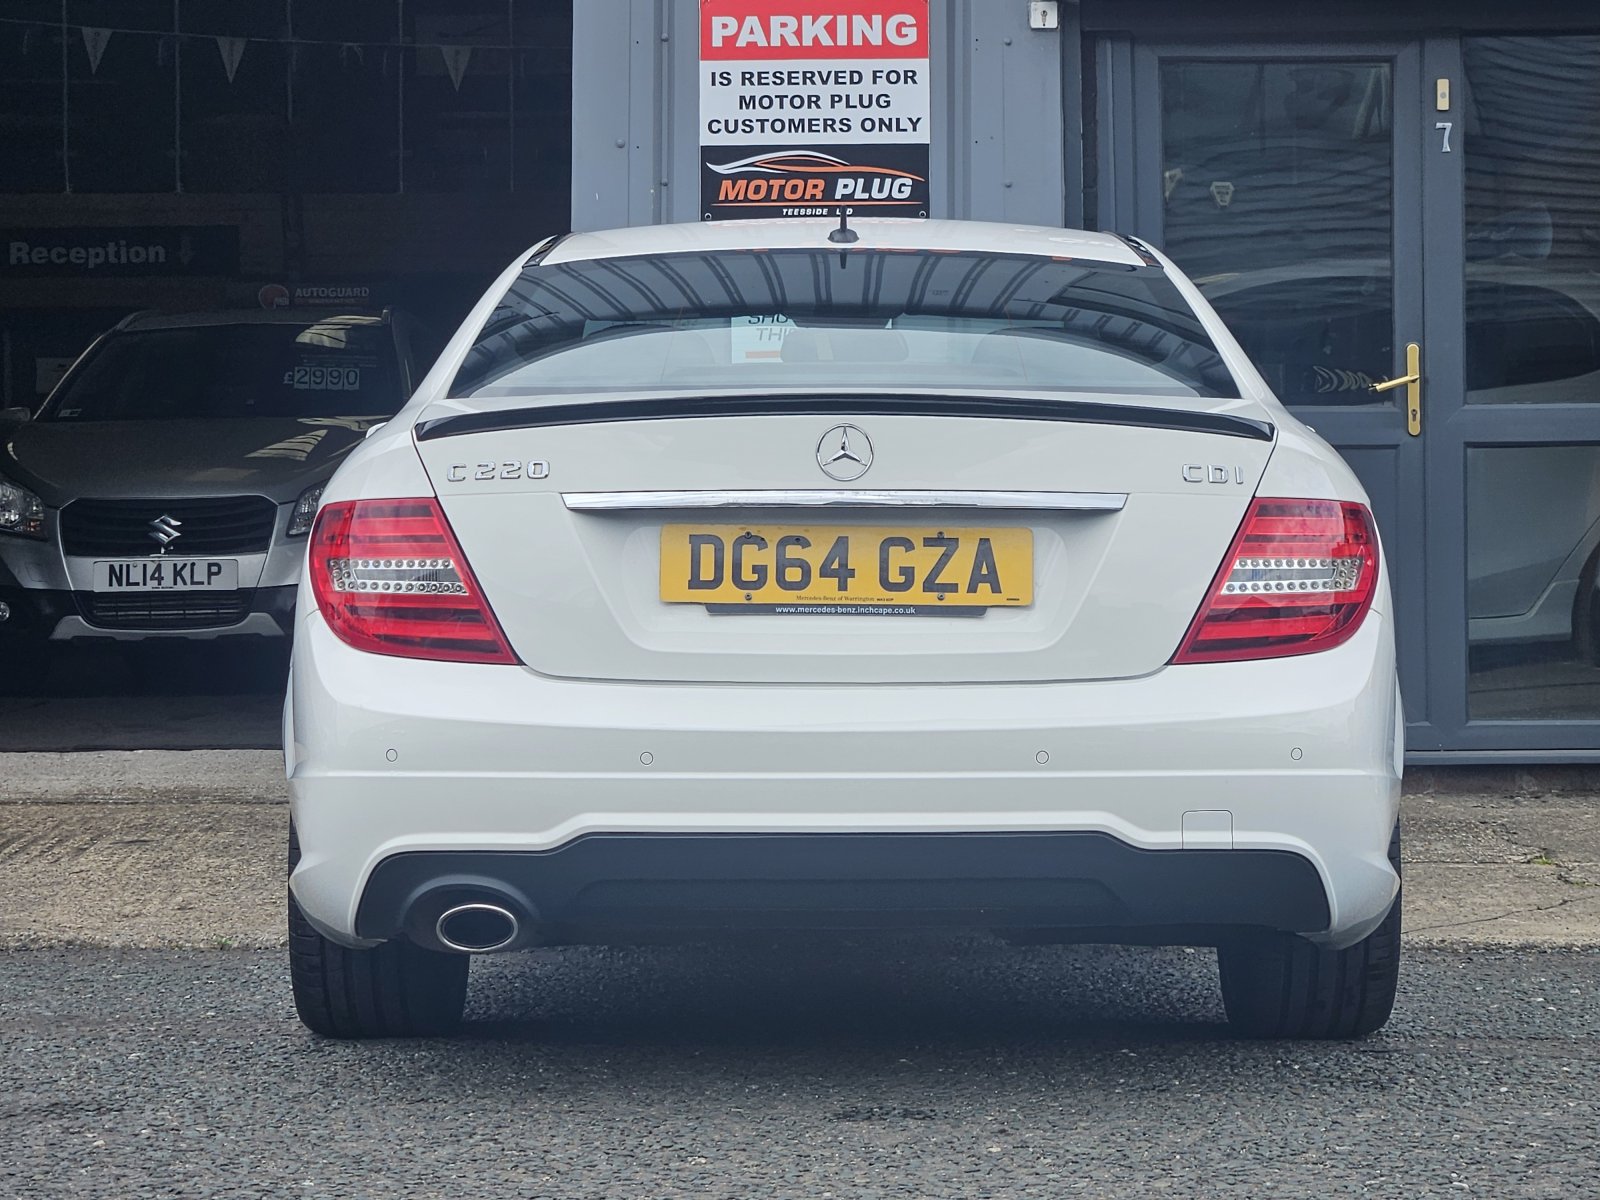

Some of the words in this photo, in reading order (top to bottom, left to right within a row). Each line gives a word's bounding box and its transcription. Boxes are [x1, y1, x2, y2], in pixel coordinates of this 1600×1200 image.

[711, 14, 918, 47] PARKING
[711, 71, 732, 86] IS
[741, 70, 863, 86] RESERVED
[872, 70, 918, 85] FOR
[739, 94, 821, 110] MOTOR
[830, 93, 891, 109] PLUG
[707, 118, 852, 134] CUSTOMERS
[860, 117, 922, 132] ONLY
[1435, 122, 1452, 152] 7
[718, 179, 825, 201] MOTOR
[834, 178, 913, 200] PLUG
[782, 208, 828, 216] TEESSIDE
[9, 240, 166, 268] Reception
[295, 286, 370, 297] AUTOGUARD
[282, 368, 360, 387] £2990
[447, 463, 467, 482] C
[474, 459, 550, 481] 220
[1182, 463, 1244, 484] CDI
[108, 563, 165, 587] NL14
[173, 562, 222, 586] KLP
[688, 534, 856, 592] DG64
[878, 536, 1002, 595] GZA
[775, 606, 916, 616] www.mercedes-benz.inchcape.co.uk
